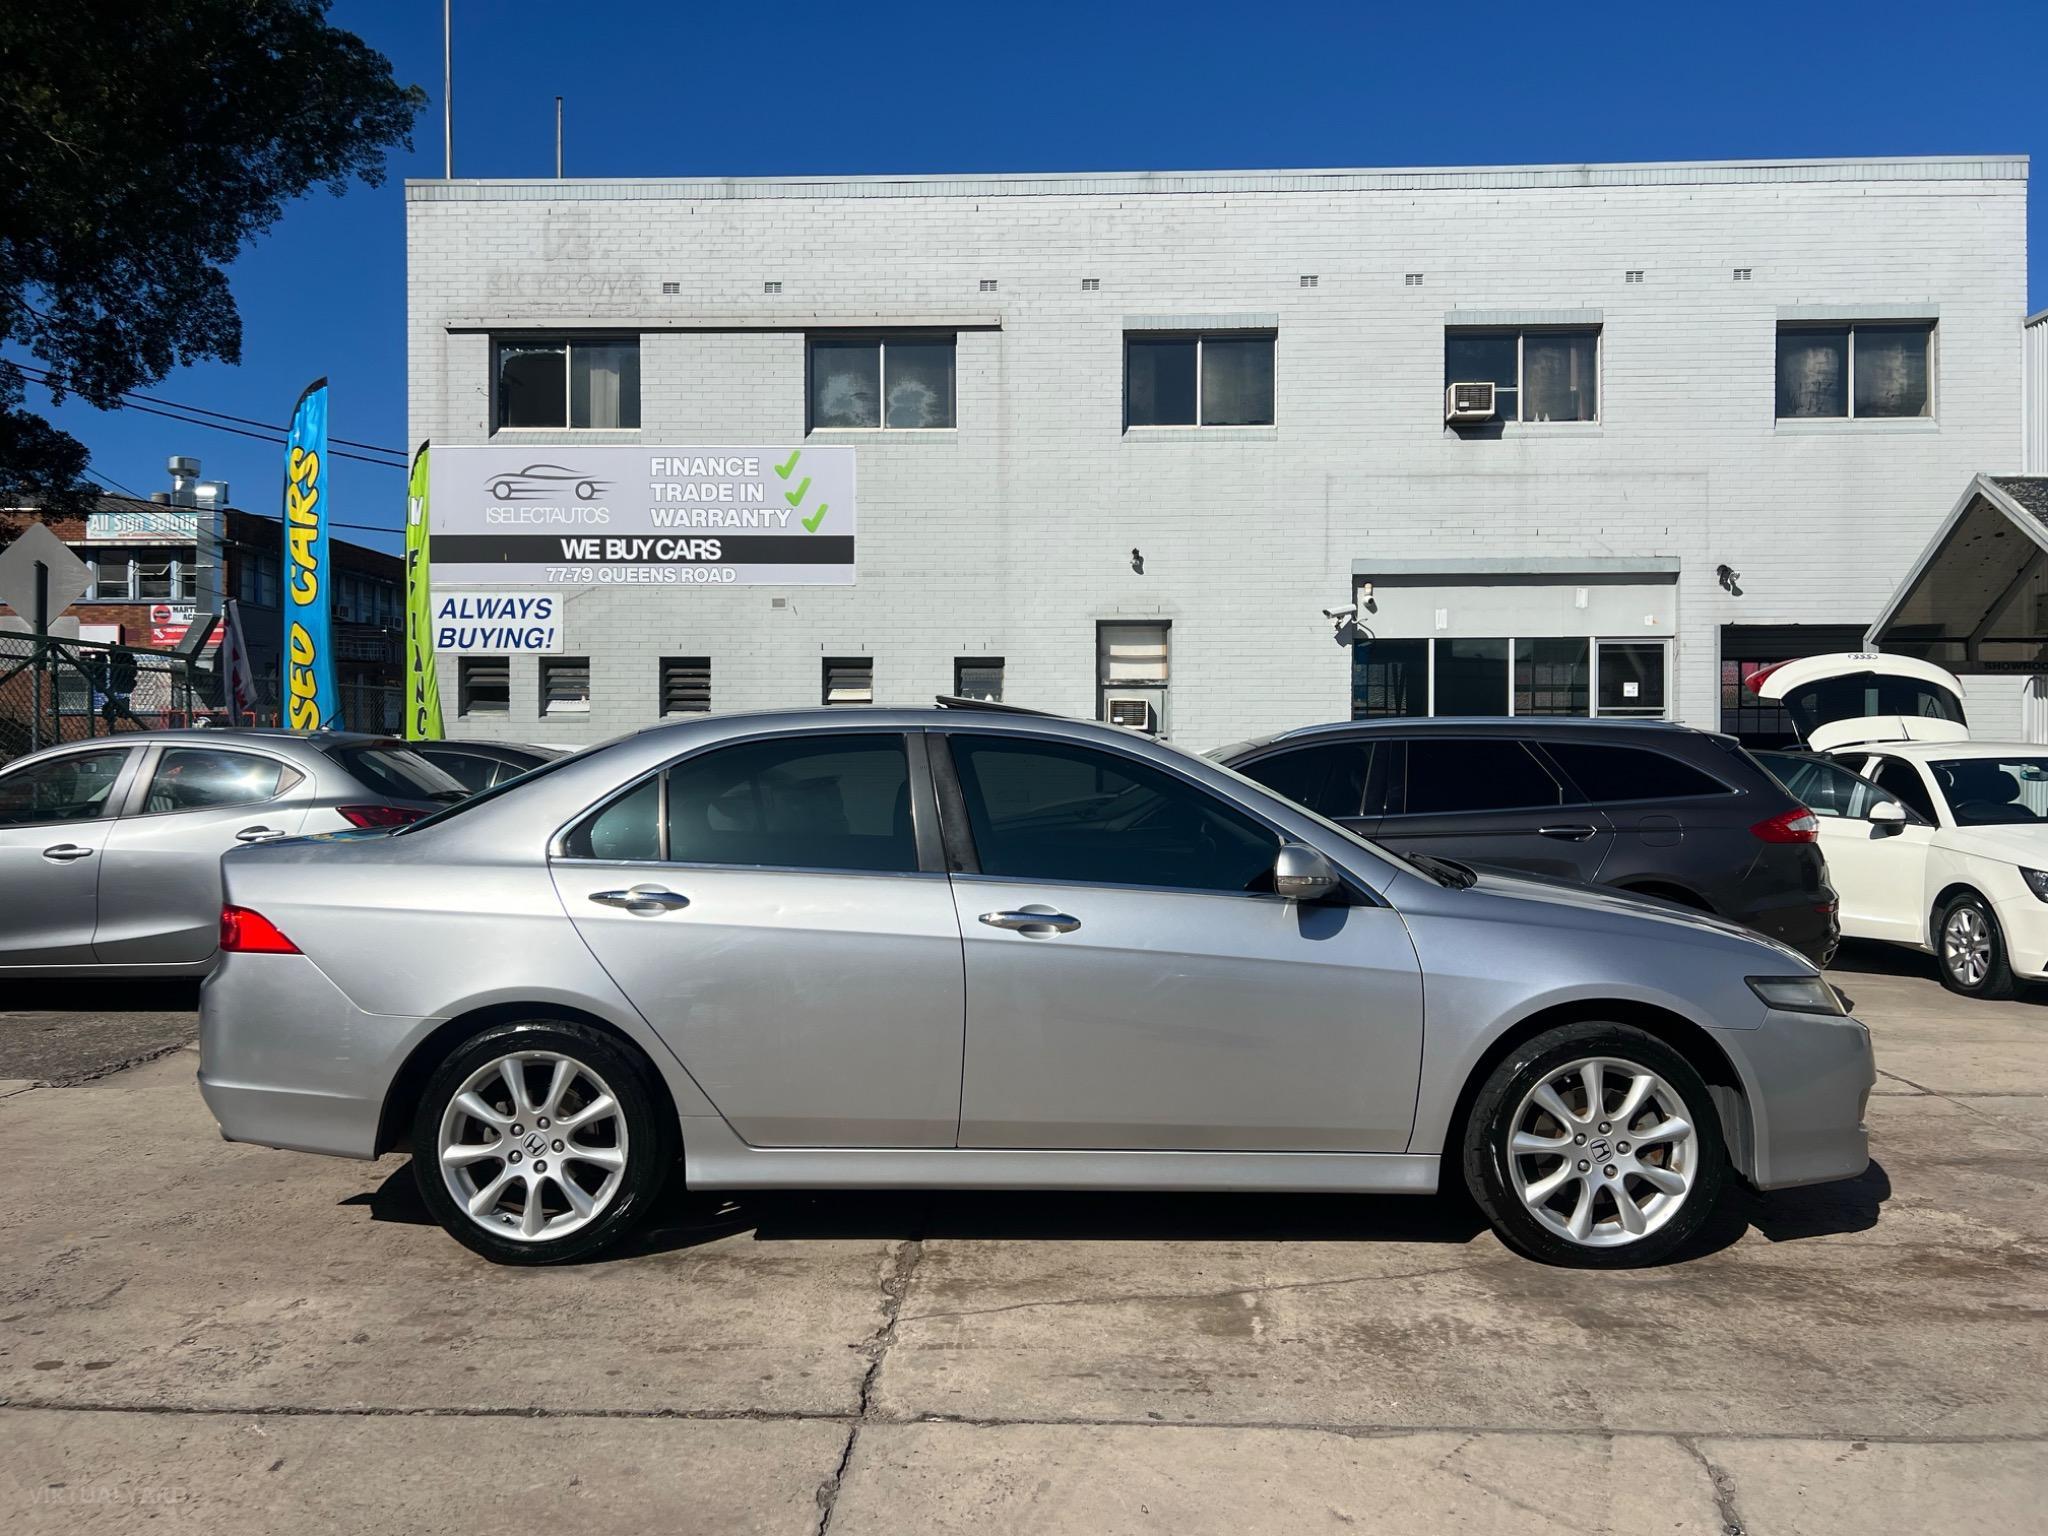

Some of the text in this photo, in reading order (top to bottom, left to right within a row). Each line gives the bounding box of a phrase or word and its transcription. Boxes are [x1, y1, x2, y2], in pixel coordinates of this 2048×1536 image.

[650, 456, 760, 477] FINANCE
[649, 482, 764, 502] TRADE IN
[91, 515, 109, 531] All
[115, 515, 144, 532] Sign
[486, 507, 610, 524] ISELECTAUTOS
[649, 507, 793, 528] WARRANTY
[560, 538, 722, 561] WE BUY CARS
[545, 567, 737, 584] 77-79 QUEENS ROAD
[287, 446, 321, 730] SED CARS
[438, 597, 553, 620] ALWAYS
[437, 627, 555, 649] BUYING!
